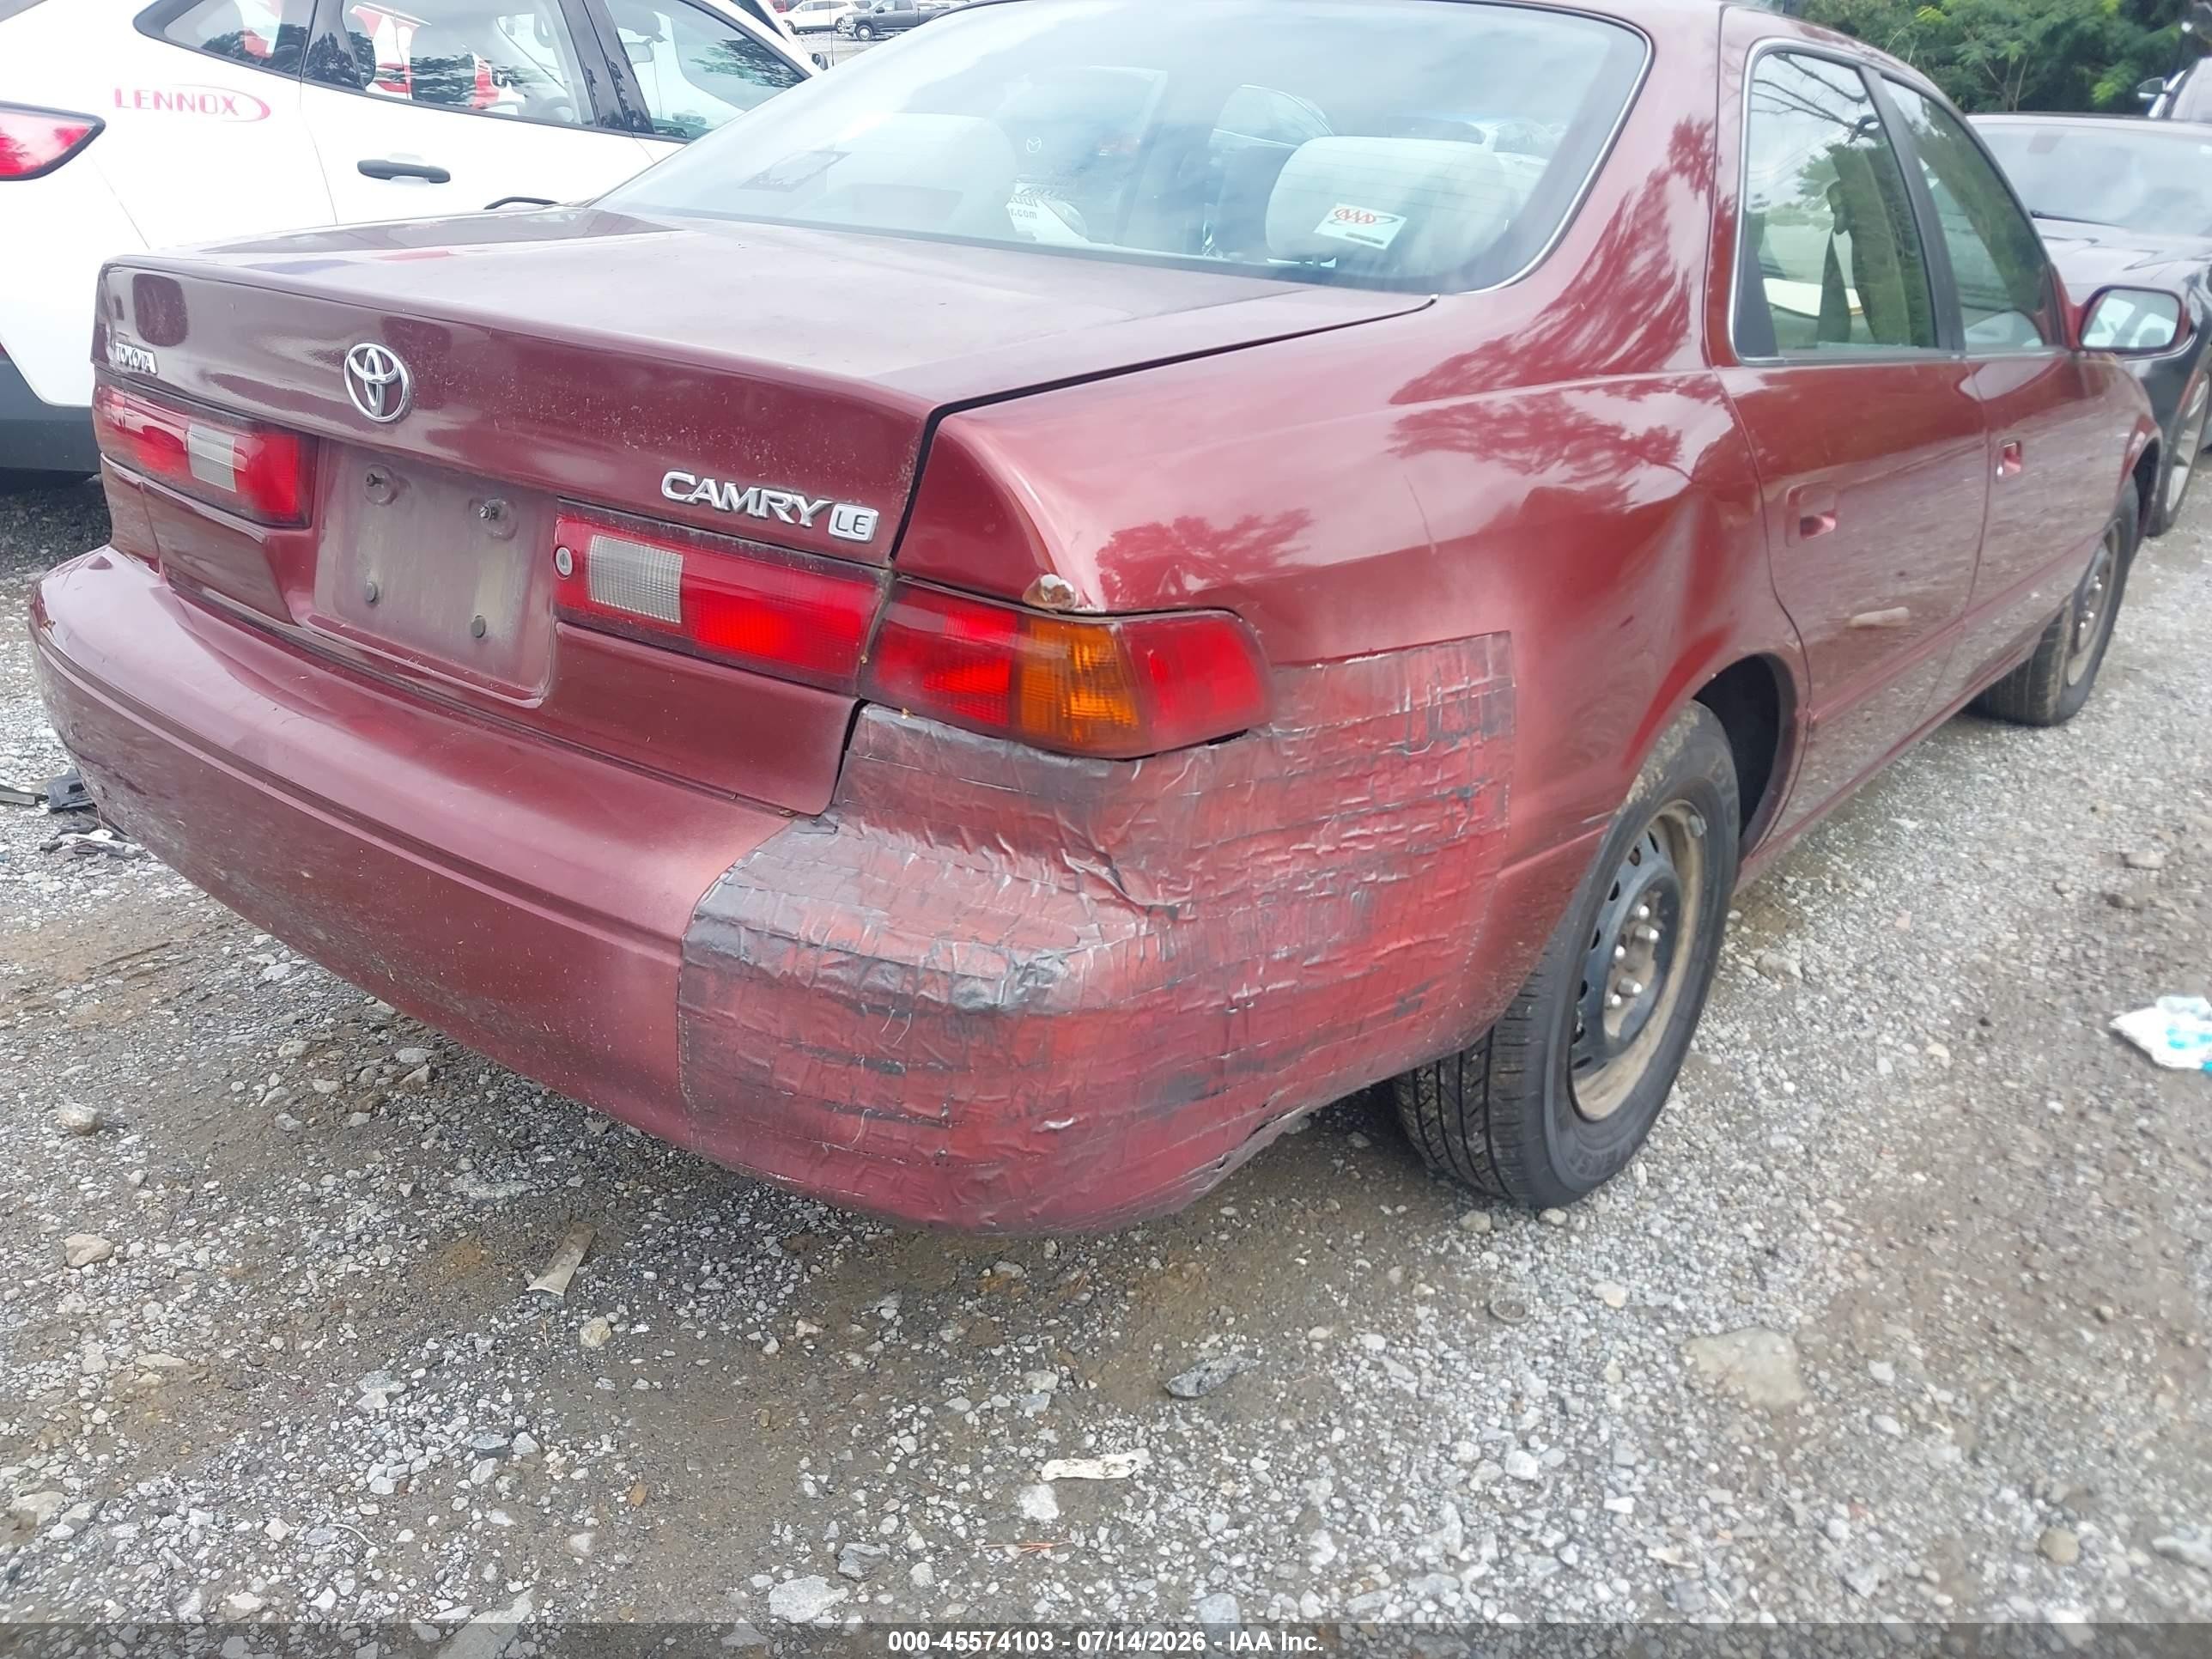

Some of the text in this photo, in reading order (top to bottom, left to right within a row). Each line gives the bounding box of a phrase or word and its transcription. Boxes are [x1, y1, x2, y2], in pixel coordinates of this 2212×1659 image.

[115, 88, 240, 116] LENNOX
[115, 342, 158, 372] TOYOTA
[660, 470, 871, 537] CAMRY LE
